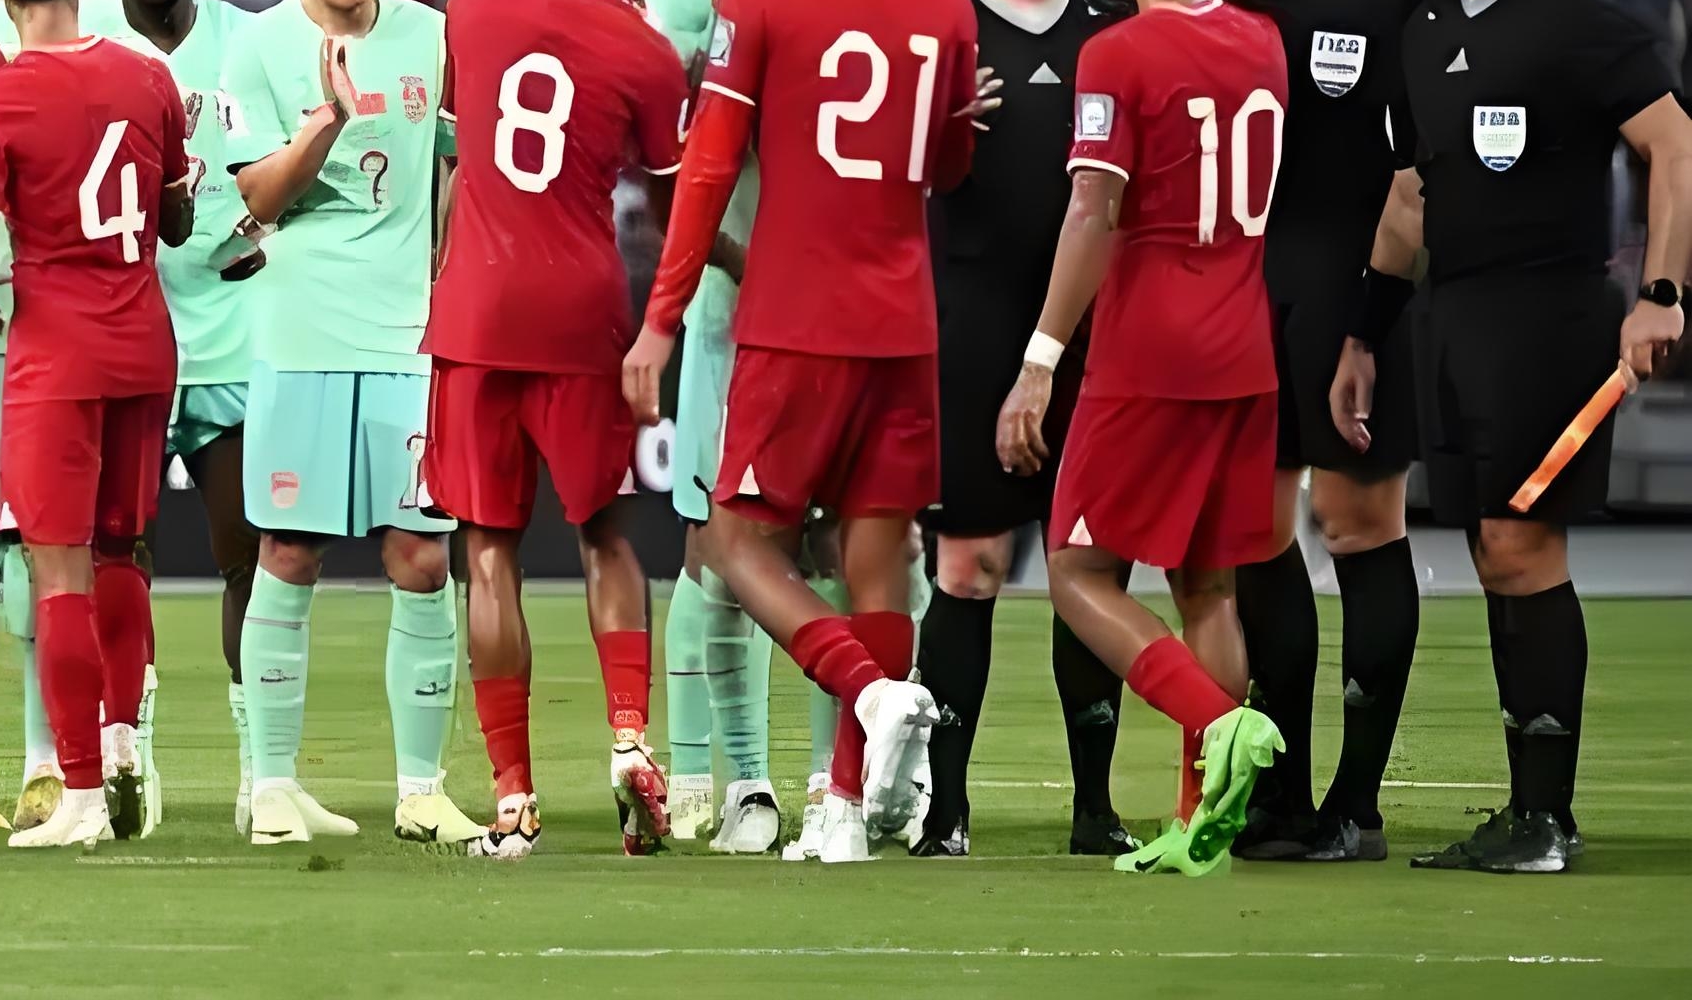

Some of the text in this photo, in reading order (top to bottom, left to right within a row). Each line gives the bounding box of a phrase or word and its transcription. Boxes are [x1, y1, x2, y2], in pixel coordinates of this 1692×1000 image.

[494, 52, 575, 194] 8
[816, 30, 939, 182] 21
[1187, 88, 1285, 245] 10
[78, 119, 147, 264] 4
